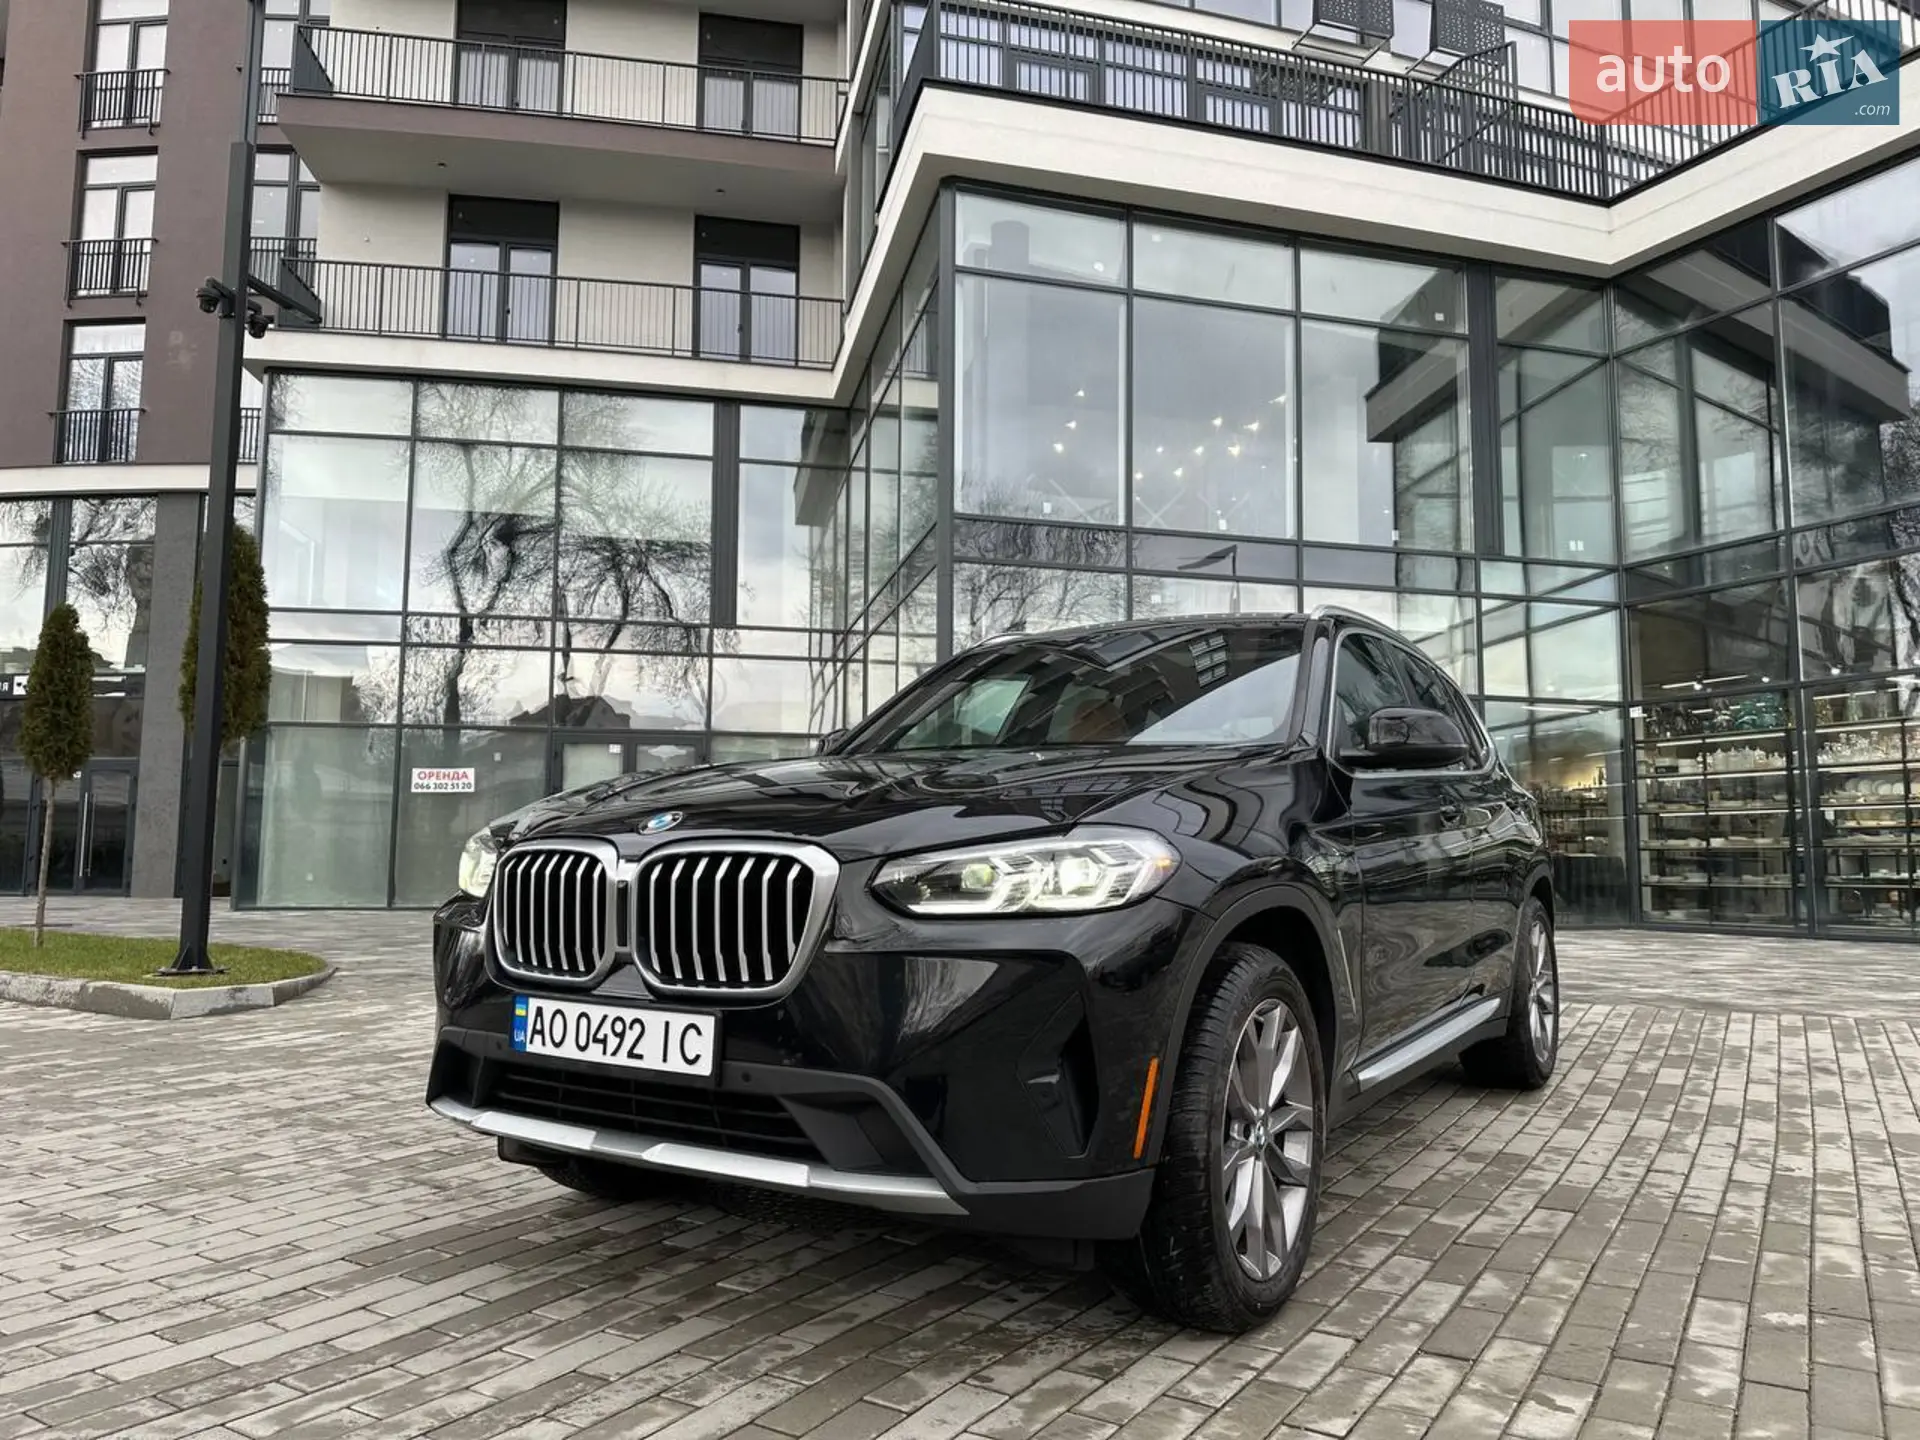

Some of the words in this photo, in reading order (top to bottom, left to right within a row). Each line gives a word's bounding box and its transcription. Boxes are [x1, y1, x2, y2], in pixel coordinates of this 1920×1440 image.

[417, 771, 469, 780] ОРЕНДА
[414, 782, 431, 790] 066
[432, 782, 449, 790] 302
[450, 782, 460, 790] 51
[461, 782, 472, 790] 20
[529, 1005, 568, 1048] AO
[575, 1011, 646, 1060] 0492
[662, 1020, 702, 1066] IC
